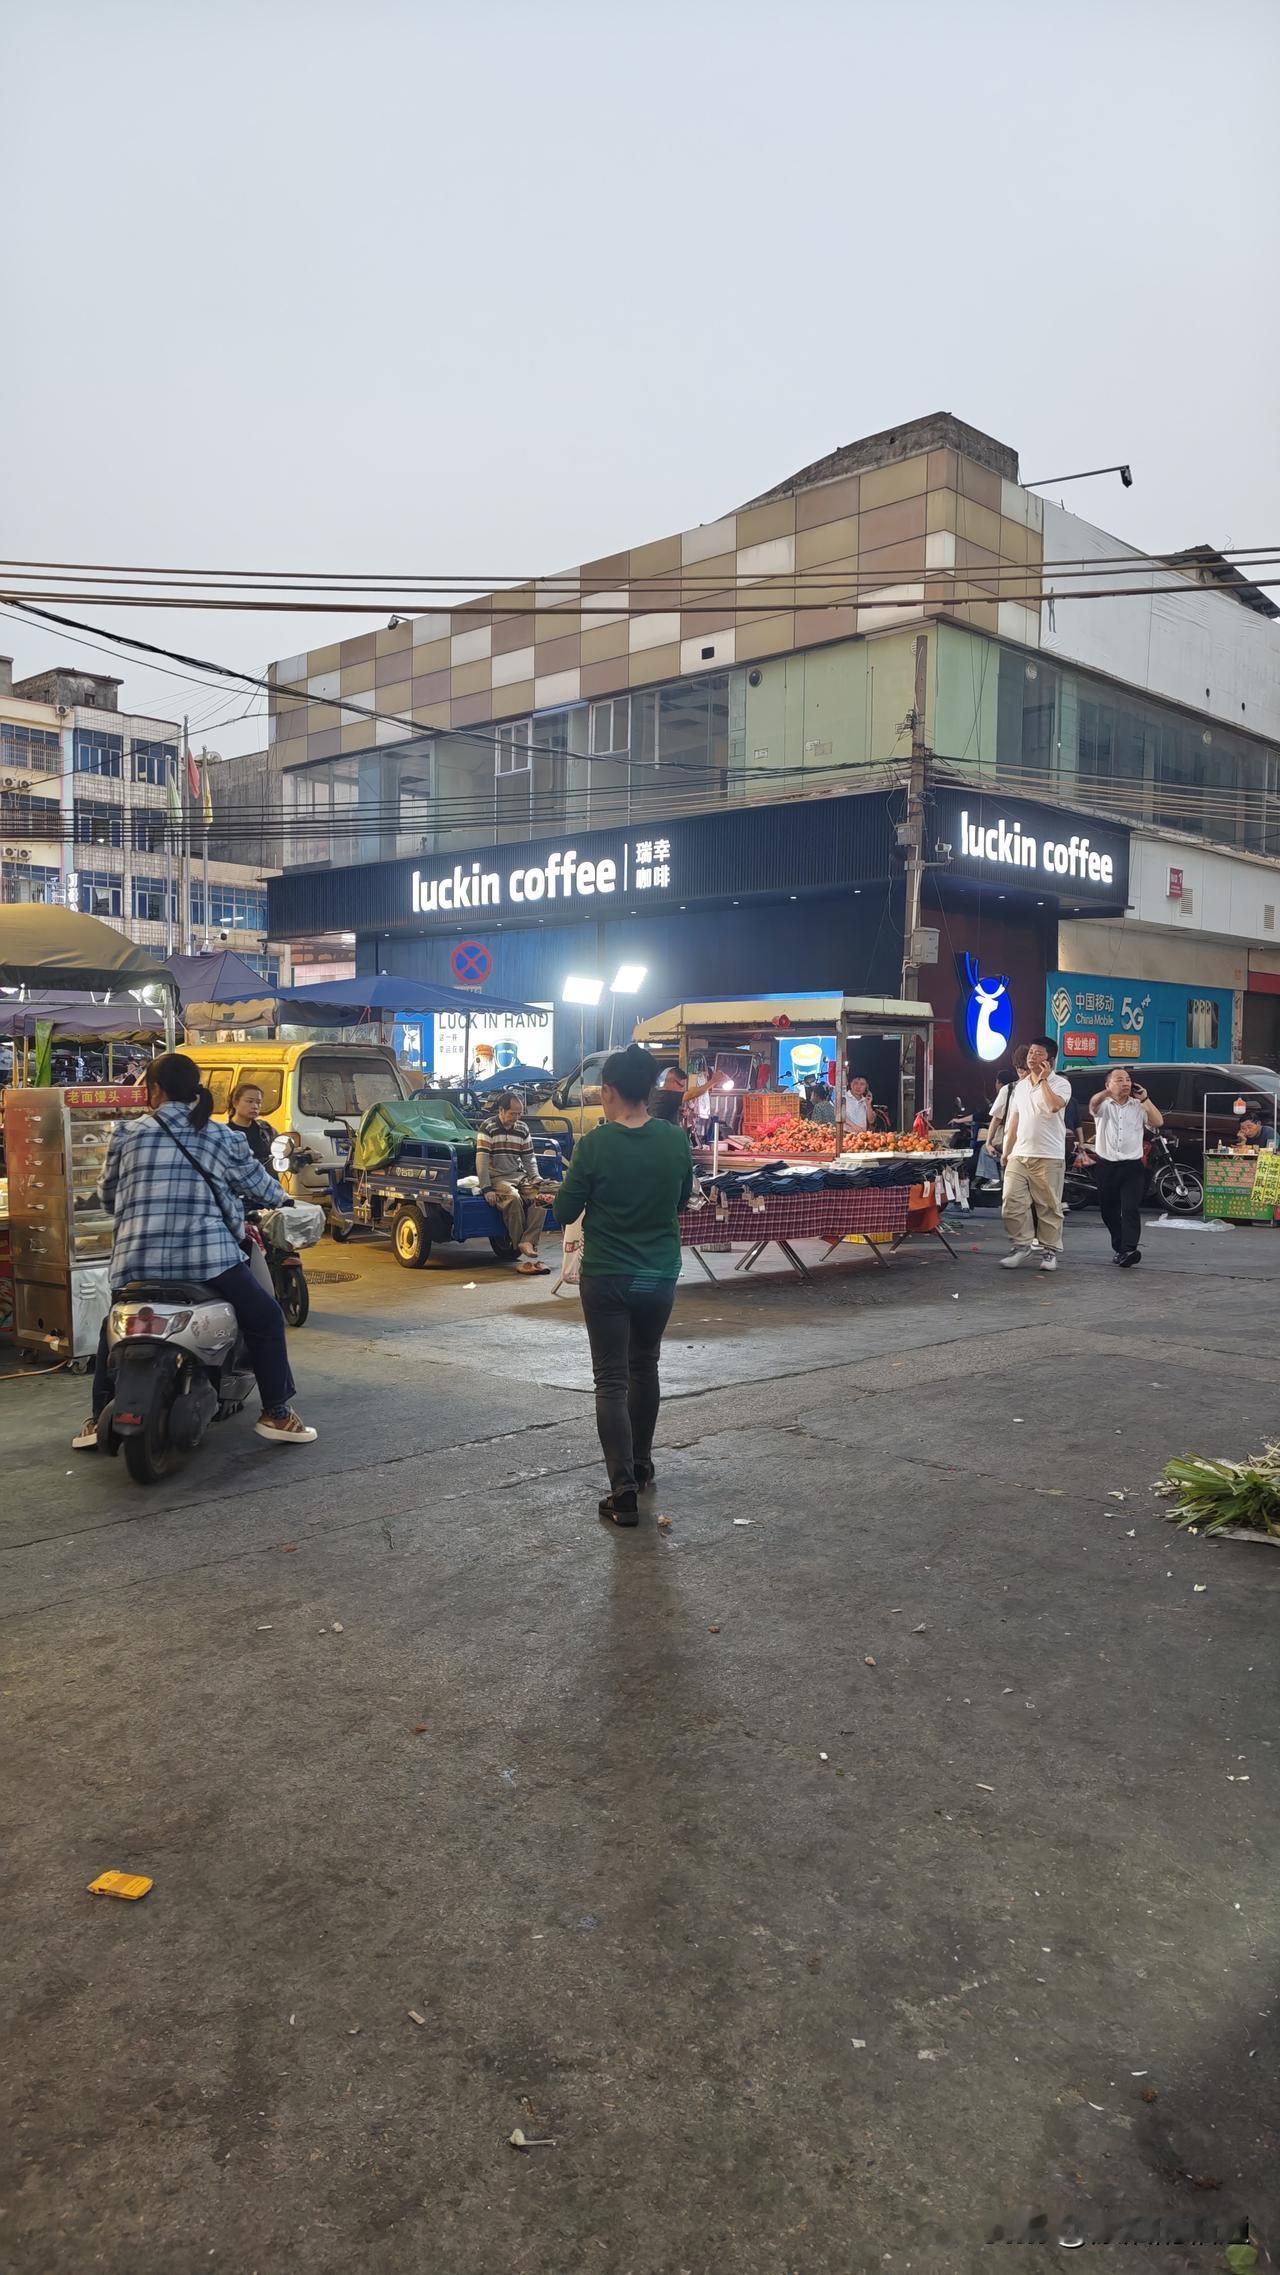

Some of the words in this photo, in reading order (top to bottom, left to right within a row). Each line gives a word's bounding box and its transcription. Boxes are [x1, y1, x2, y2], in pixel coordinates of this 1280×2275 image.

[635, 838, 671, 864] 瑞幸
[961, 810, 1037, 869] luckin
[1043, 836, 1113, 884] coffee
[412, 862, 500, 913] luckin
[509, 850, 616, 902] coffee
[635, 865, 671, 889] 咖啡
[1075, 992, 1115, 1012] 中国移动
[439, 1013, 478, 1029] LUCK
[484, 1013, 498, 1029] IN
[504, 1012, 549, 1029] HAND
[1075, 1012, 1093, 1025] China
[1094, 1014, 1114, 1026] Mobile
